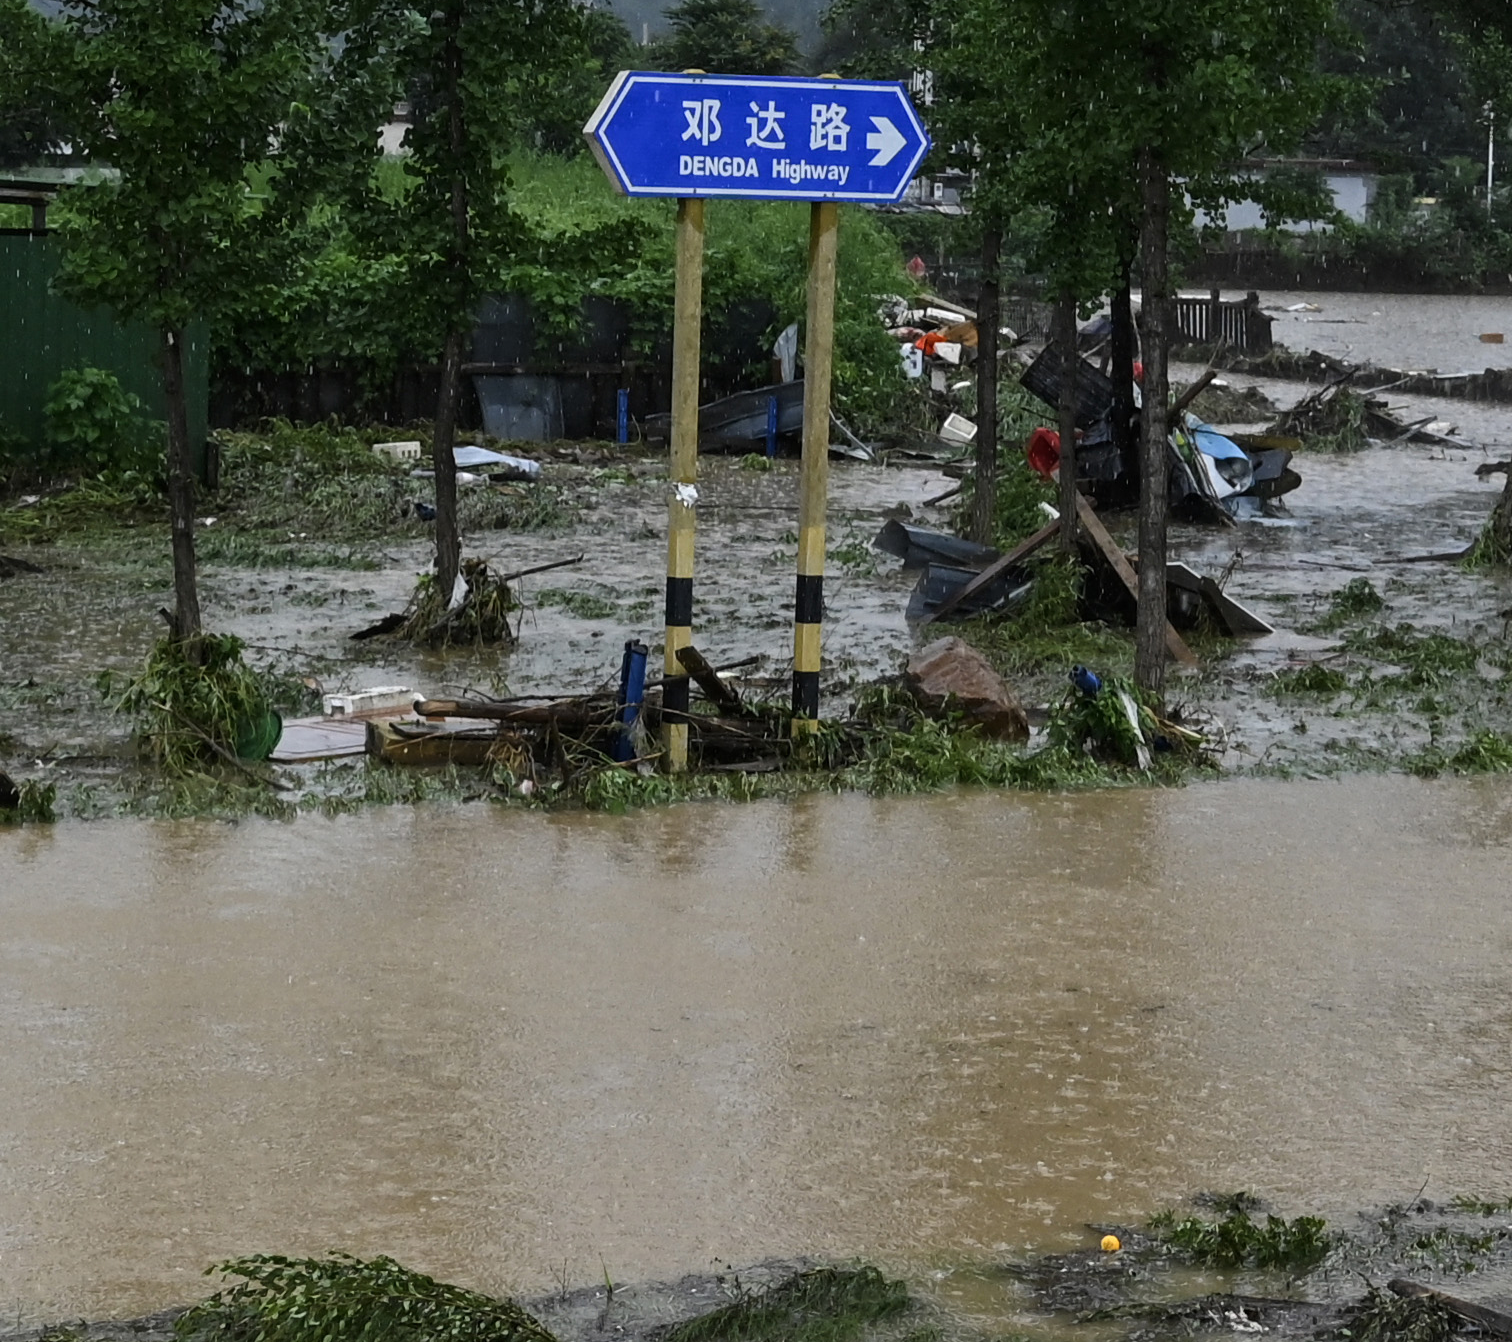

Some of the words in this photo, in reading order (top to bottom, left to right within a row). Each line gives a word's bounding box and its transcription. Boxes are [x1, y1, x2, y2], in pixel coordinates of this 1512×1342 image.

[681, 99, 851, 151] 邓达路
[679, 155, 759, 178] DENGDA
[772, 158, 850, 186] Highway
